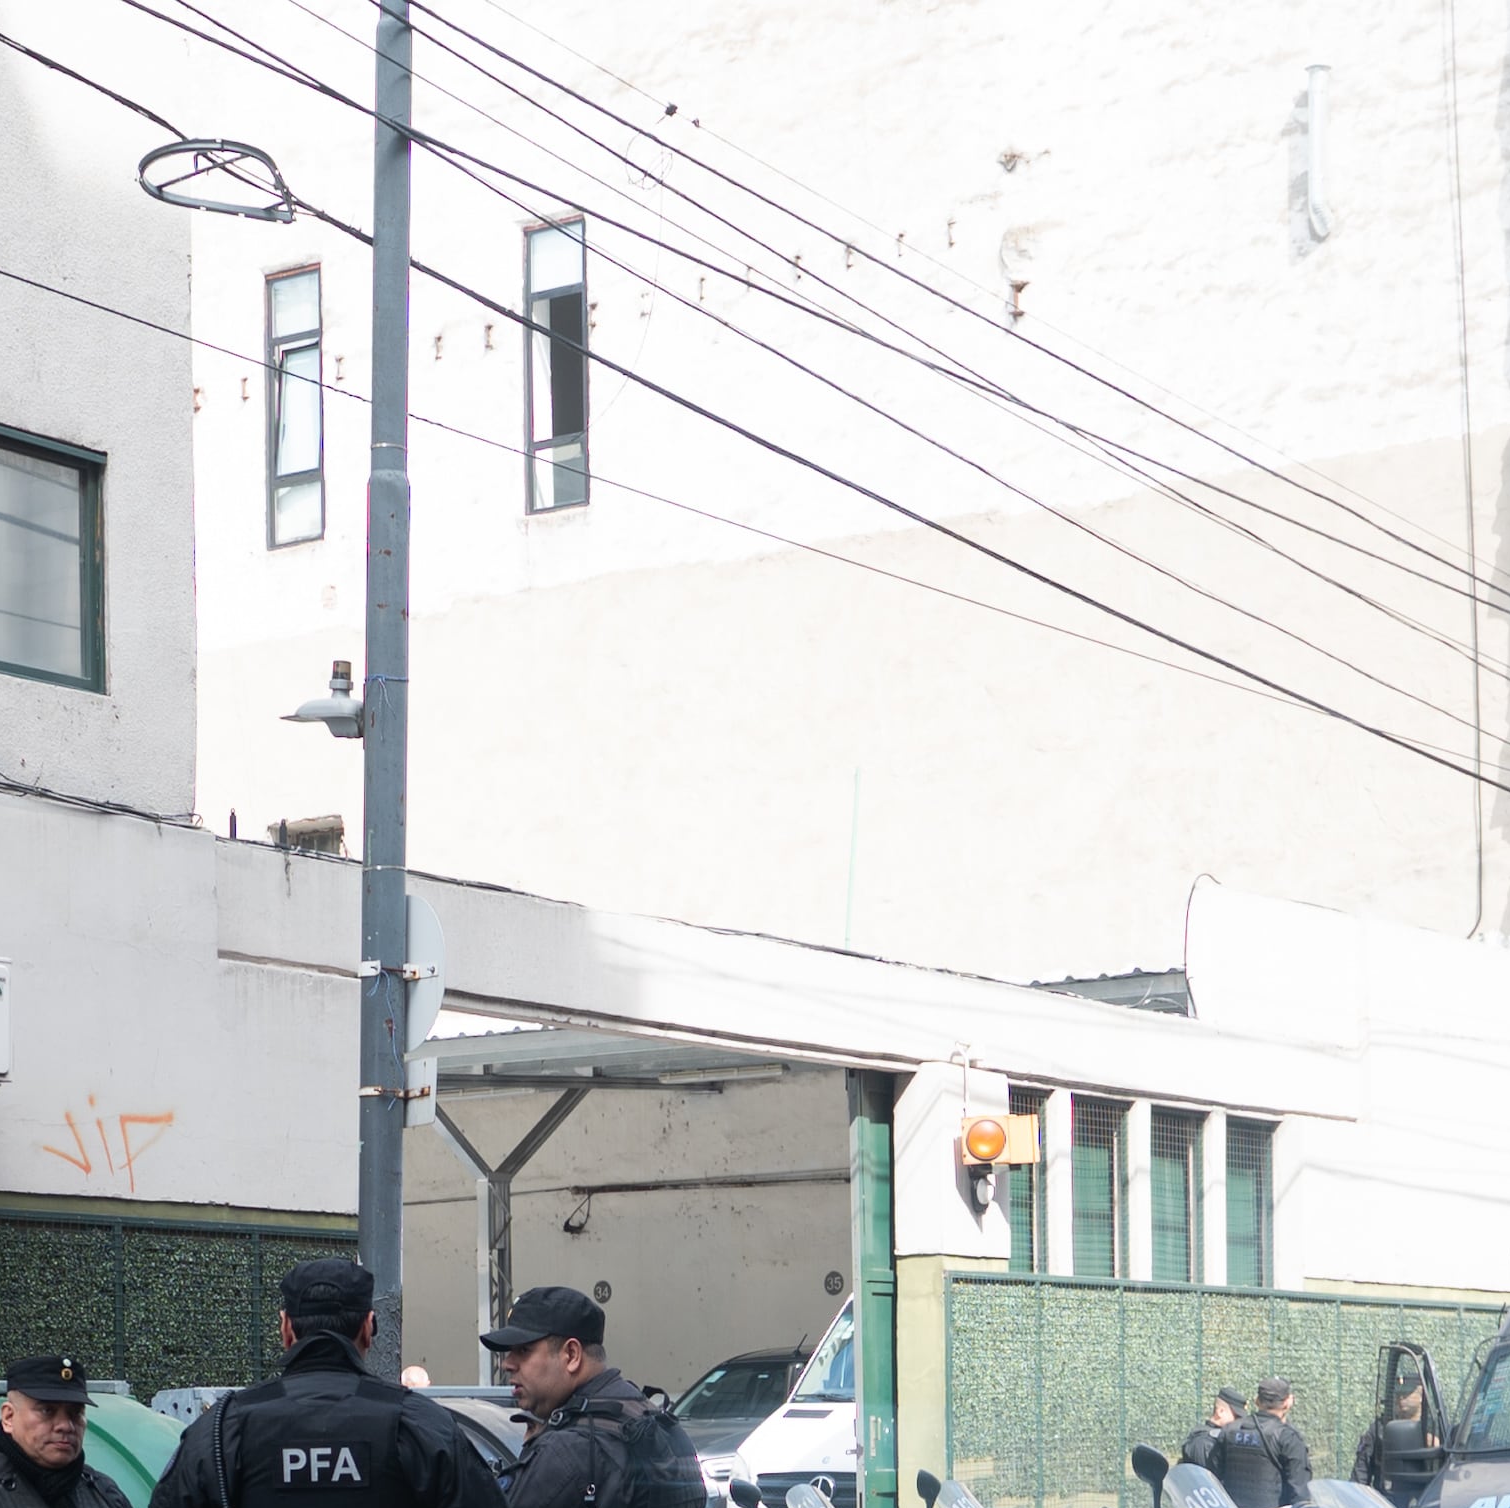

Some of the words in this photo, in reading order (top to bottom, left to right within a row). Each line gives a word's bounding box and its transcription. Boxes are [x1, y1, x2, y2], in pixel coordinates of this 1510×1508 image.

[826, 1277, 841, 1290] 35
[595, 1285, 610, 1299] 34
[282, 1447, 361, 1483] PFA
